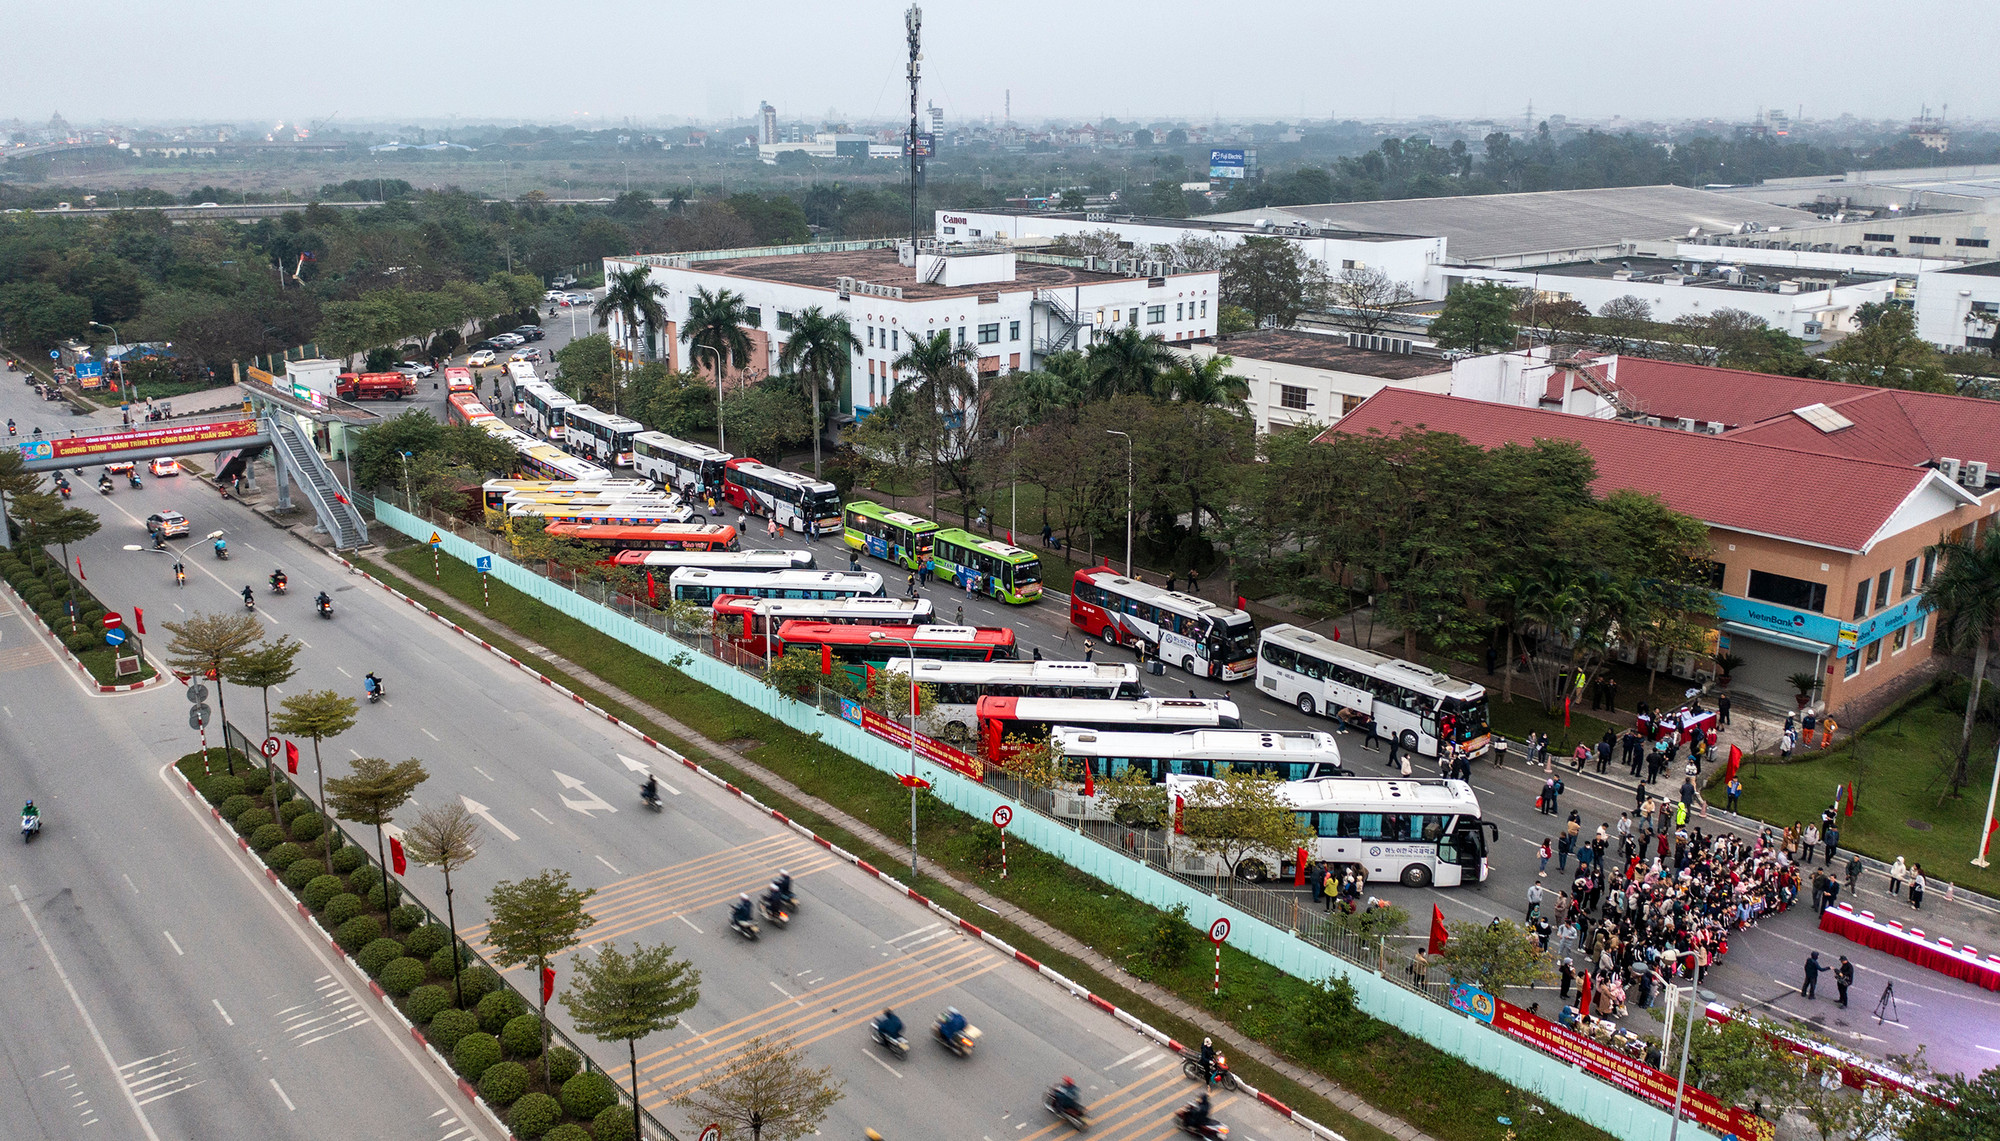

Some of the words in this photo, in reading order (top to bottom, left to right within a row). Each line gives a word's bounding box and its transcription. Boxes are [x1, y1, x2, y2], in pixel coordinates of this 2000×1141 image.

[942, 214, 967, 224] Canon
[60, 445, 86, 455] CHƯƠNG
[88, 443, 106, 451] TRÌNH
[130, 438, 148, 447] TRÌNH
[150, 437, 159, 445] TẾT
[161, 435, 177, 444] CÔNG
[201, 431, 216, 439] XUÂN
[1748, 610, 1793, 627] VietinBank
[1215, 924, 1224, 937] 60
[1551, 1026, 1562, 1034] LIÊN
[1563, 1031, 1576, 1041] ĐOÀN
[1589, 1043, 1602, 1054] ĐỘNG
[1604, 1050, 1621, 1061] THÀNH
[1622, 1058, 1633, 1067] PHỐ
[1643, 1067, 1652, 1076] NỘI
[1503, 1012, 1520, 1025] CHƯƠNG
[1552, 1034, 1564, 1045] MIỄN
[1583, 1048, 1596, 1059] CÔNG
[1597, 1055, 1609, 1066] NHÂN
[1610, 1061, 1617, 1069] VỀ
[1617, 1064, 1626, 1074] QUÊ
[1627, 1069, 1637, 1079] ĐÓN
[1647, 1078, 1666, 1093] NGUYÊN
[1682, 1095, 1691, 1104] IÁP
[1692, 1100, 1703, 1110] THÌN
[1704, 1105, 1717, 1116] NĂM
[1717, 1111, 1729, 1122] 2024
